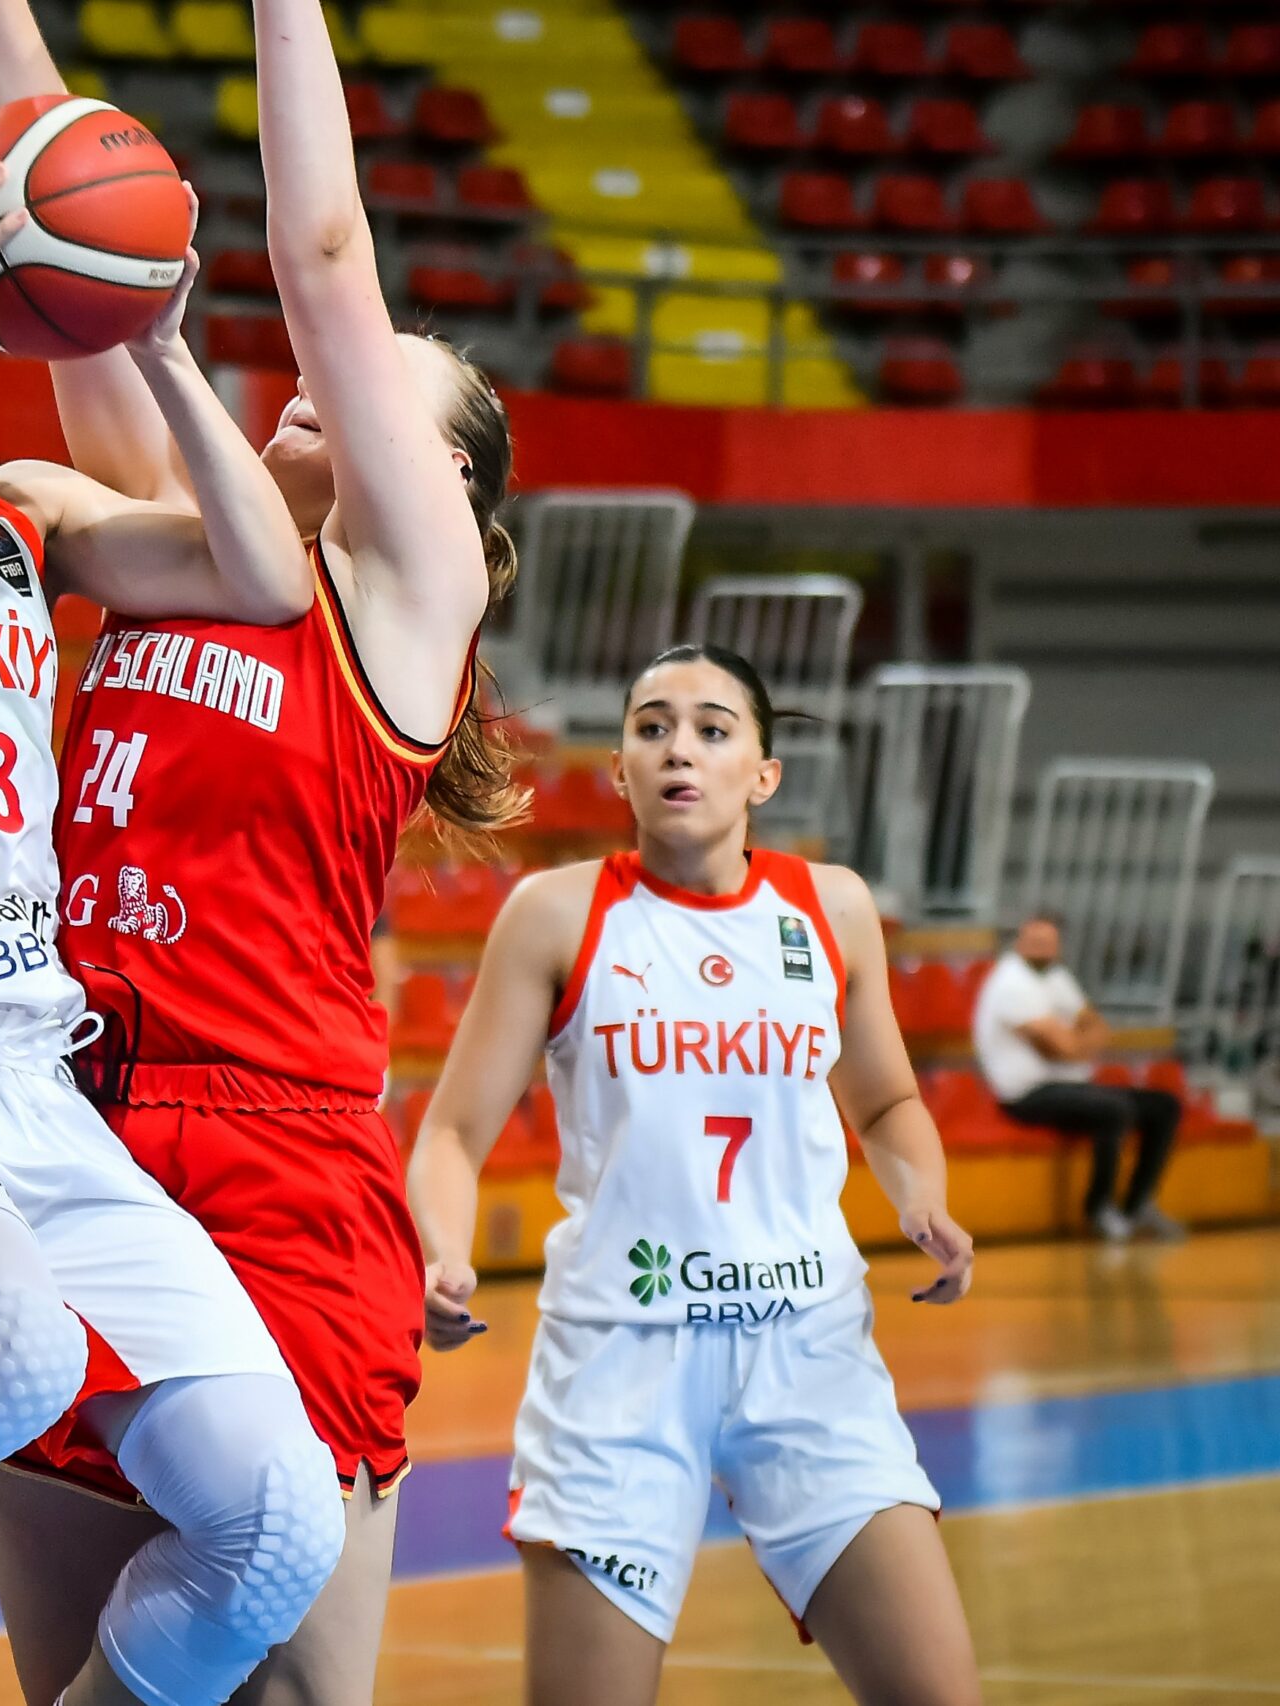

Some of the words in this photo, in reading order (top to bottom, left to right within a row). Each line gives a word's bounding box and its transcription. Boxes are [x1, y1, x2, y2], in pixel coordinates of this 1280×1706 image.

[0, 562, 24, 578] FIBA
[73, 728, 149, 828] 24
[785, 952, 810, 966] FIBA
[593, 1008, 826, 1081] TÜRKİYE
[703, 1115, 753, 1204] 7
[680, 1250, 824, 1293] Garanti
